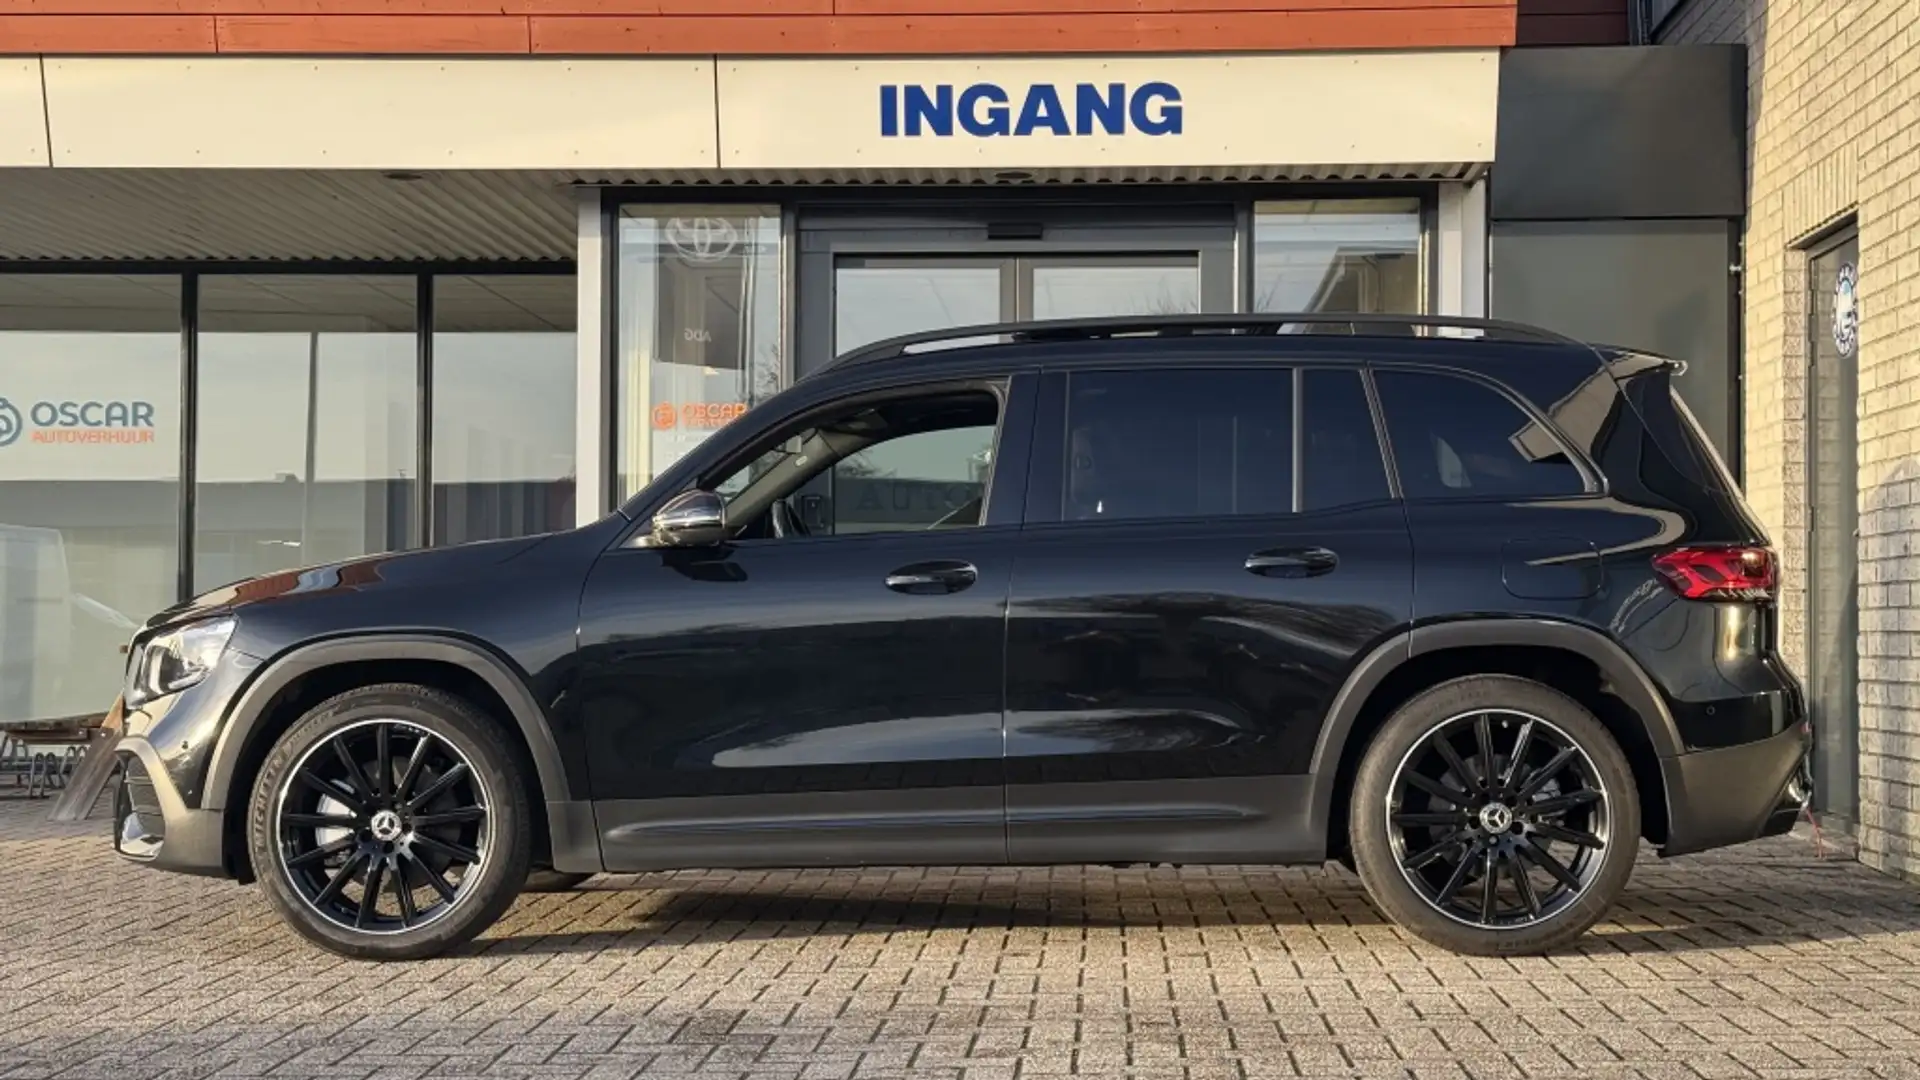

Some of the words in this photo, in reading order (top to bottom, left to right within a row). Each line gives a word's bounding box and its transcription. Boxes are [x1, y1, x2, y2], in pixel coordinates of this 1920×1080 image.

[880, 82, 1182, 136] INGANG
[31, 401, 154, 427] OSCAR
[31, 430, 155, 444] AUTOVERHUUR
